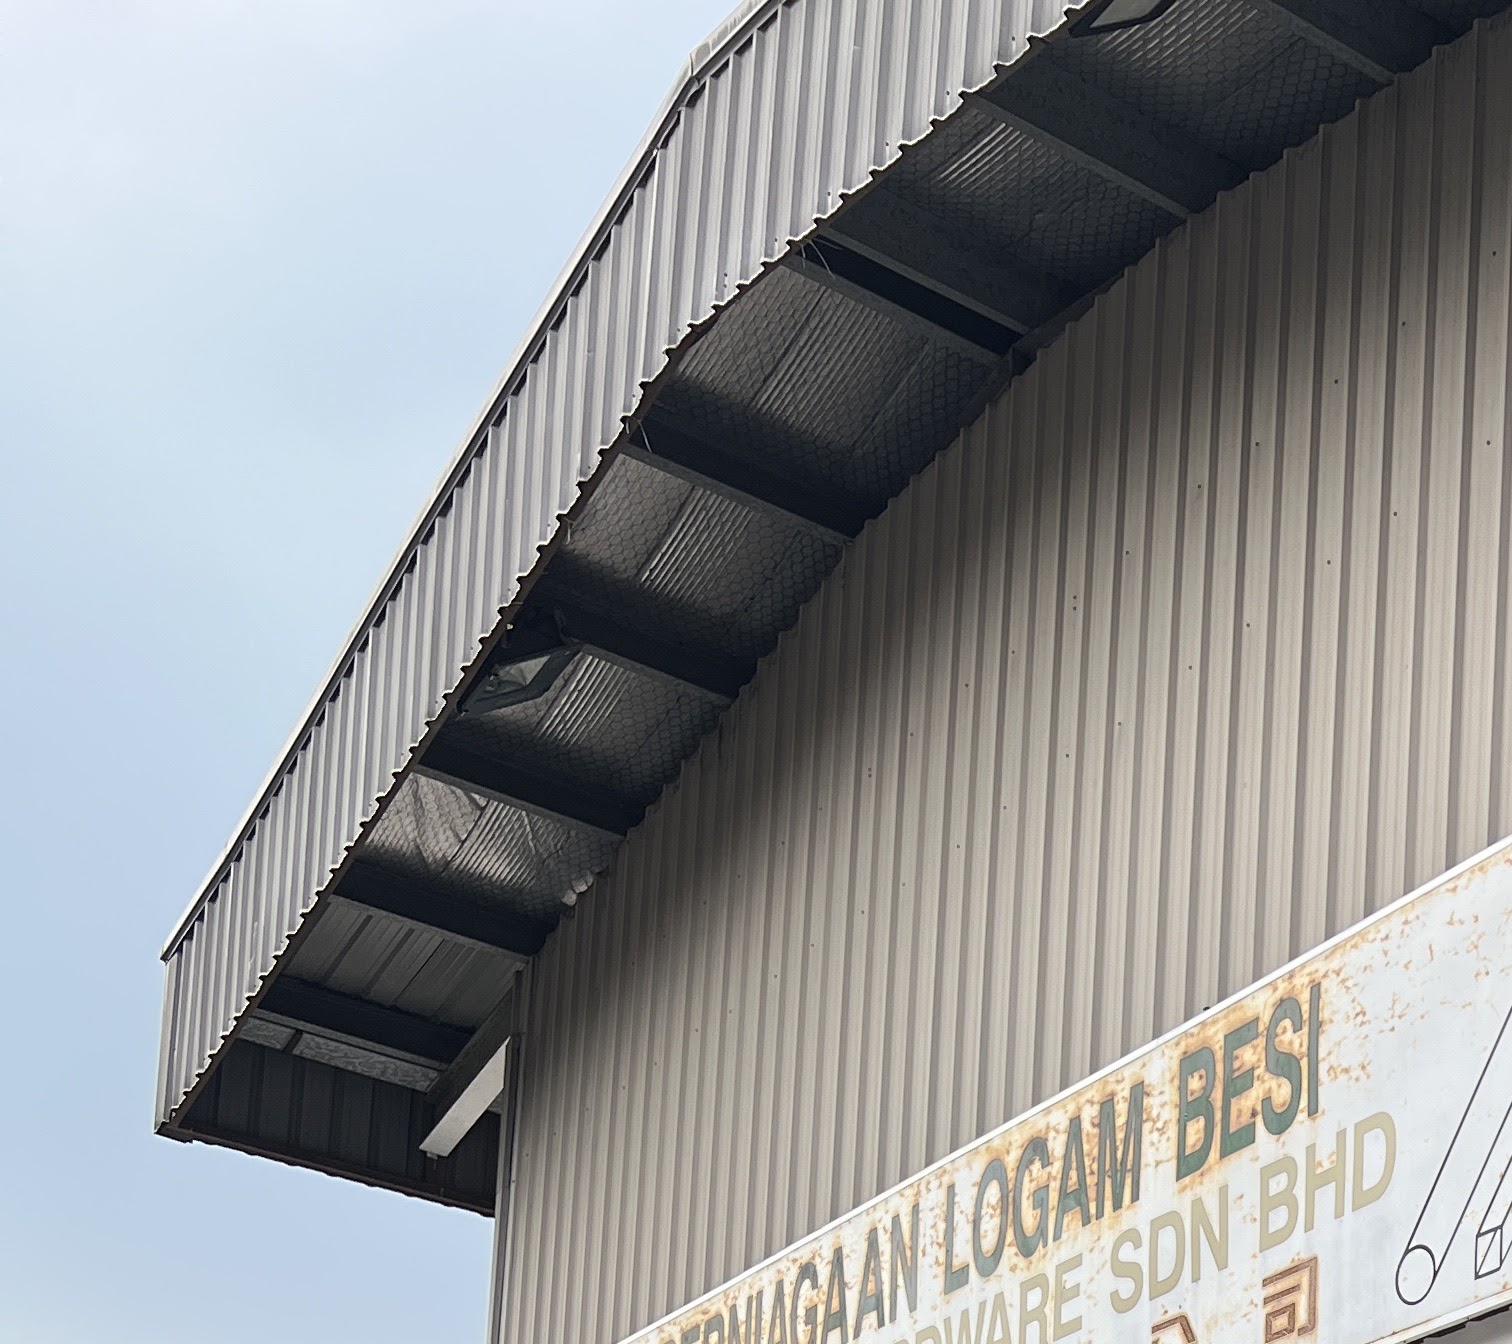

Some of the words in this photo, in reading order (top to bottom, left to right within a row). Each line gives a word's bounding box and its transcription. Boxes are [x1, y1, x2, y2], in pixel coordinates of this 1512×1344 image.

[943, 1081, 1145, 1296] LOGAM
[1176, 983, 1321, 1183] BESI
[1110, 1184, 1230, 1314] SDN
[1259, 1111, 1397, 1254] BHD
